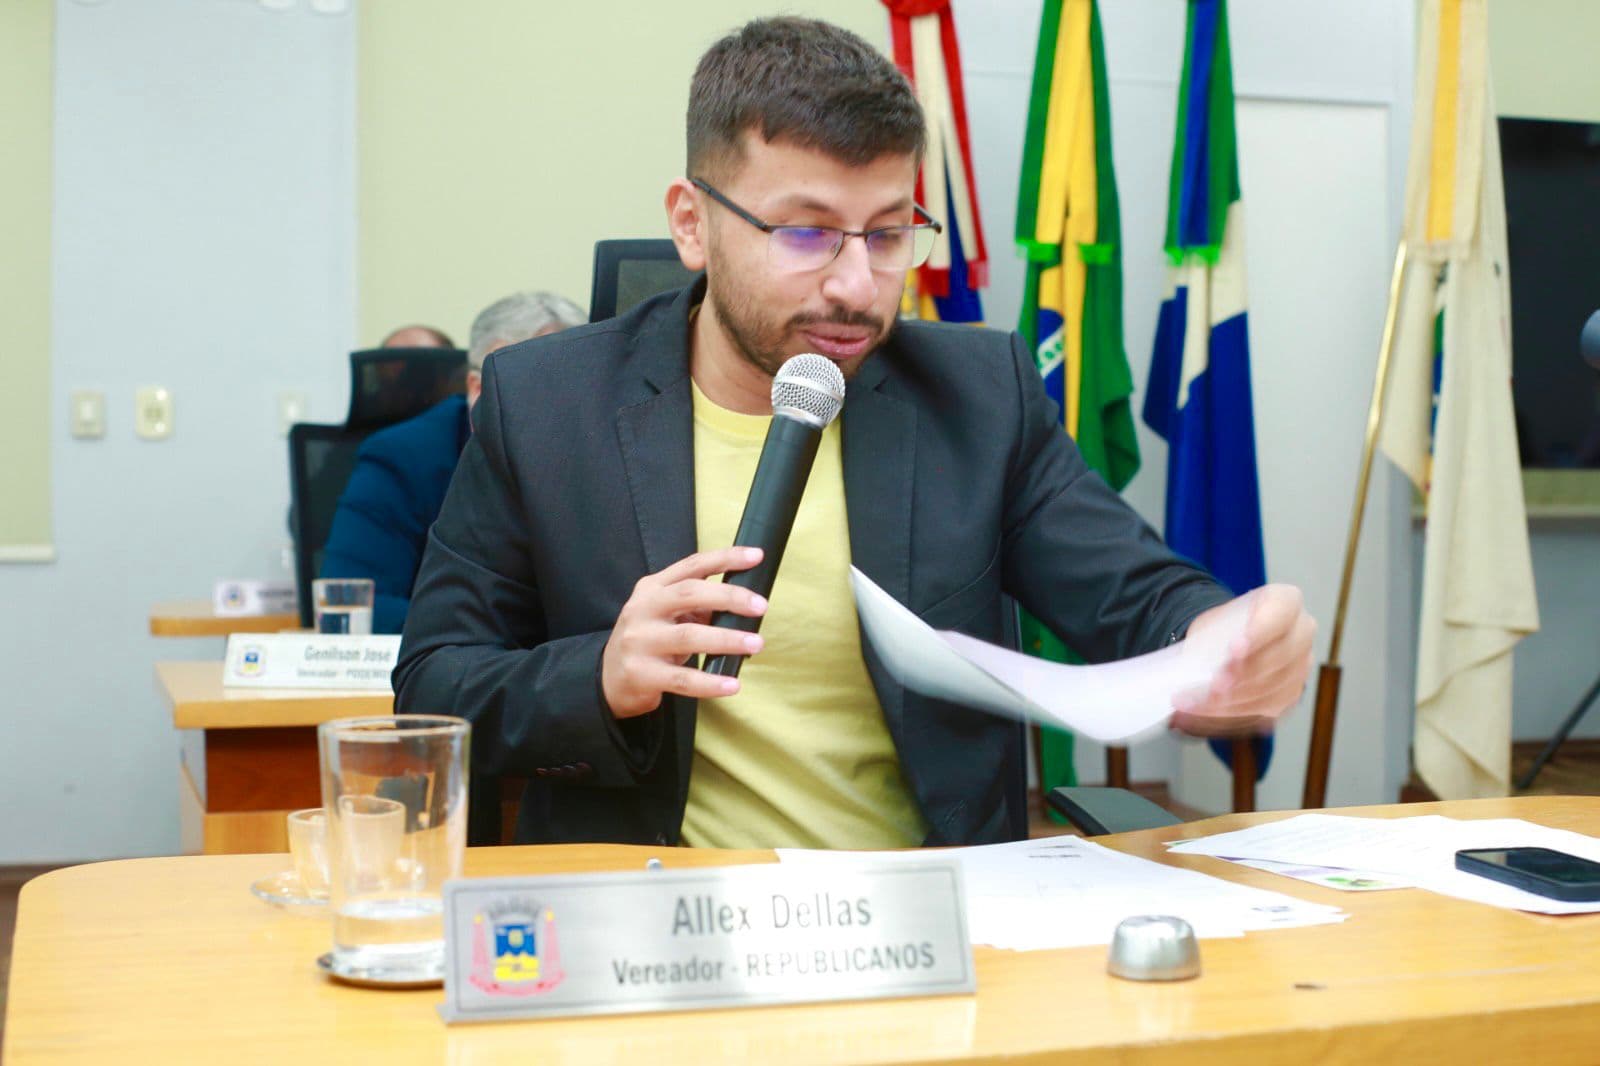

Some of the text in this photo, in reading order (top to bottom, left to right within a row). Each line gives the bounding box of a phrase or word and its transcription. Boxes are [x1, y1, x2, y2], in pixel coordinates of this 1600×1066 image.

[304, 644, 360, 662] Genilson
[671, 892, 872, 936] Allex Dellas
[612, 957, 724, 985] Vereador
[746, 942, 936, 977] REPUBLICANOS
